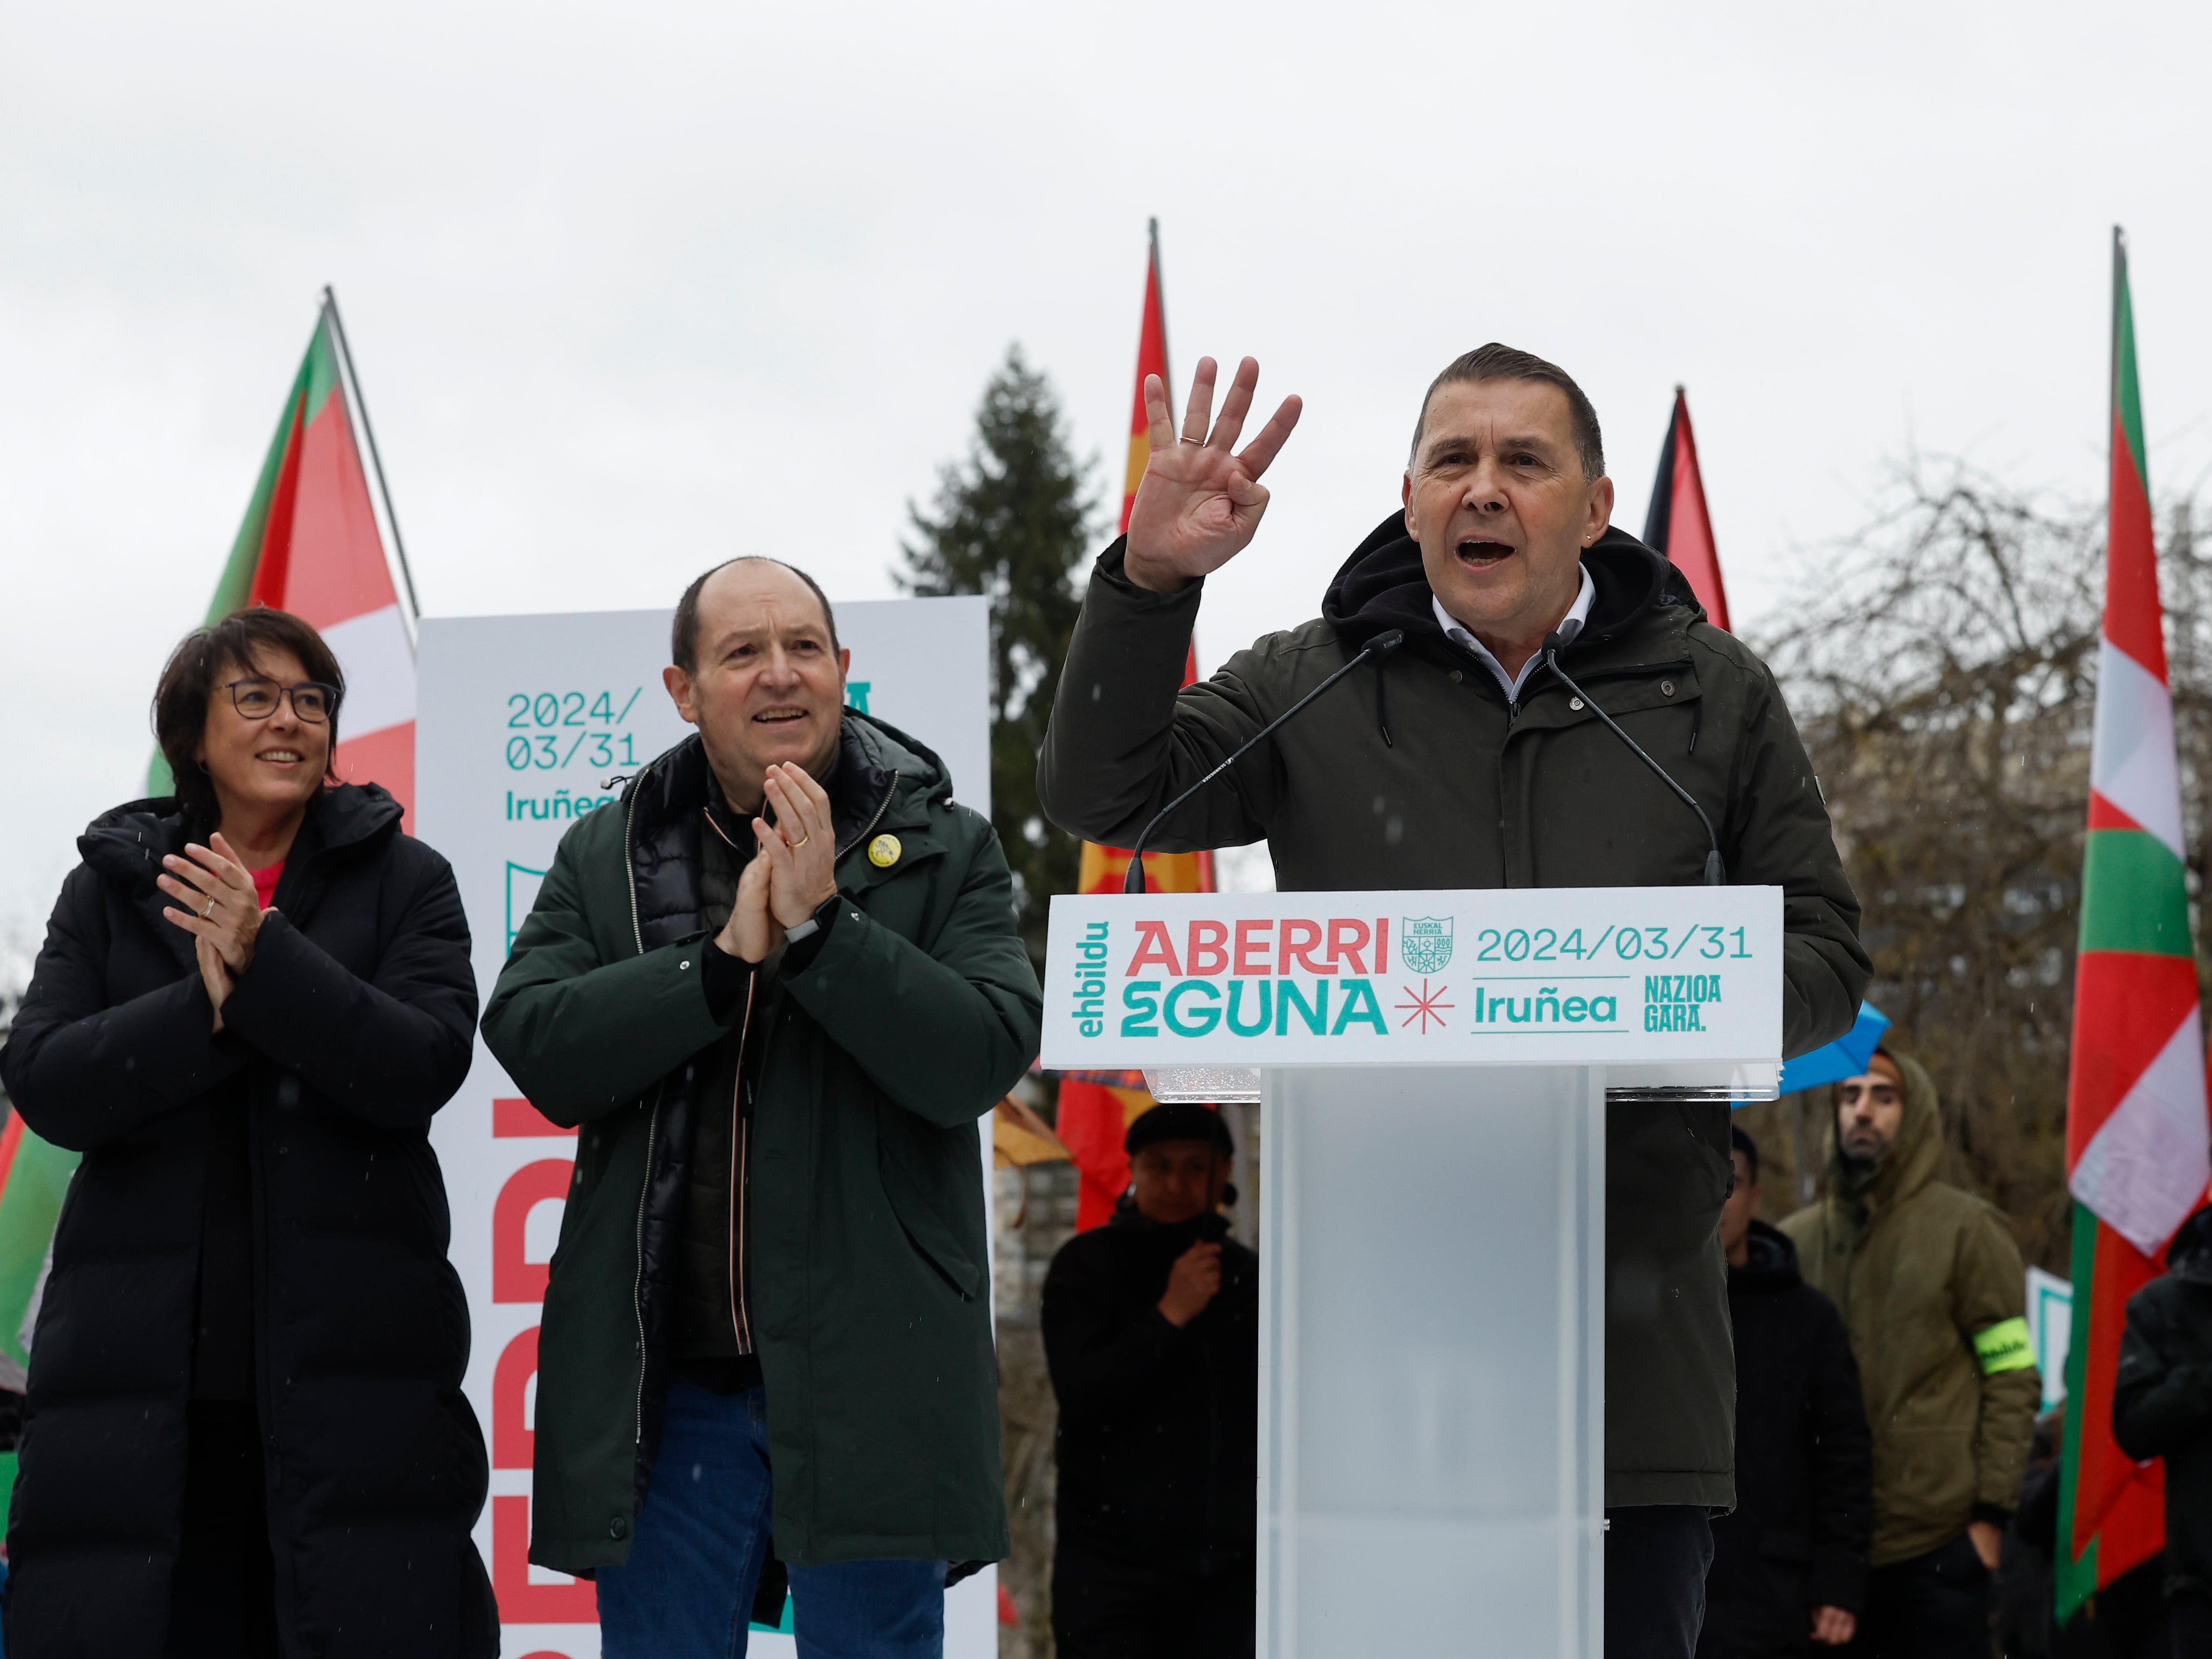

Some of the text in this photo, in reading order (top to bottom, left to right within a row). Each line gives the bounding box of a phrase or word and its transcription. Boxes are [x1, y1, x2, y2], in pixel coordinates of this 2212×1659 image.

[508, 687, 642, 728] 2024/
[507, 731, 640, 771] 03/31
[1126, 918, 1389, 977] ABERRI
[1477, 924, 1753, 962] 2024/03/31
[1071, 921, 1109, 1038] ehbildu
[1645, 974, 1722, 1003] NAZIOA
[1476, 987, 1617, 1023] Iruñea
[1644, 1004, 1707, 1033] GARA.
